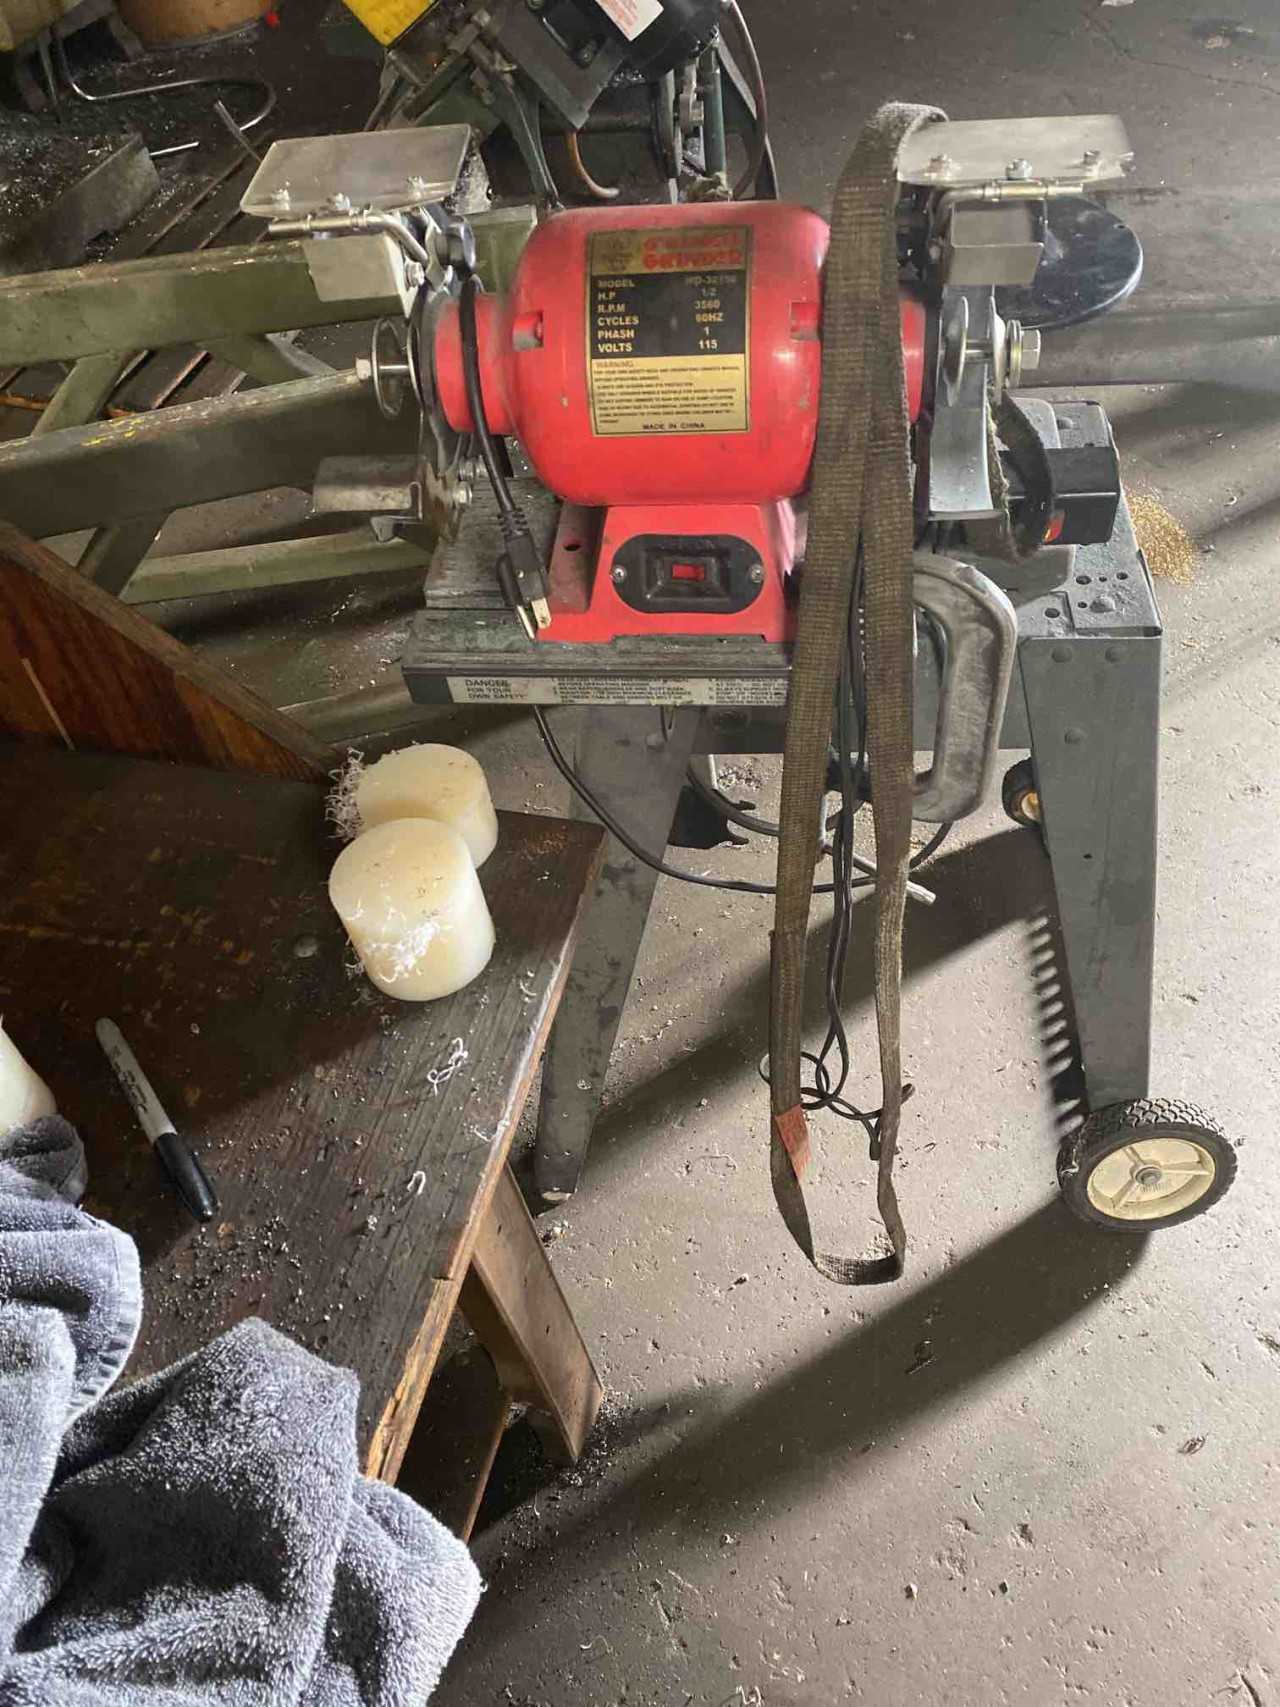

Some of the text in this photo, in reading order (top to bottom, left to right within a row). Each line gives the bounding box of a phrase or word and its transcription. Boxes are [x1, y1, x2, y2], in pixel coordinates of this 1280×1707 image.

[598, 315, 640, 326] CYCLES
[598, 326, 710, 339] PHASH 1
[598, 339, 719, 353] VOLTS 115
[642, 421, 705, 430] MADE IN CHINA
